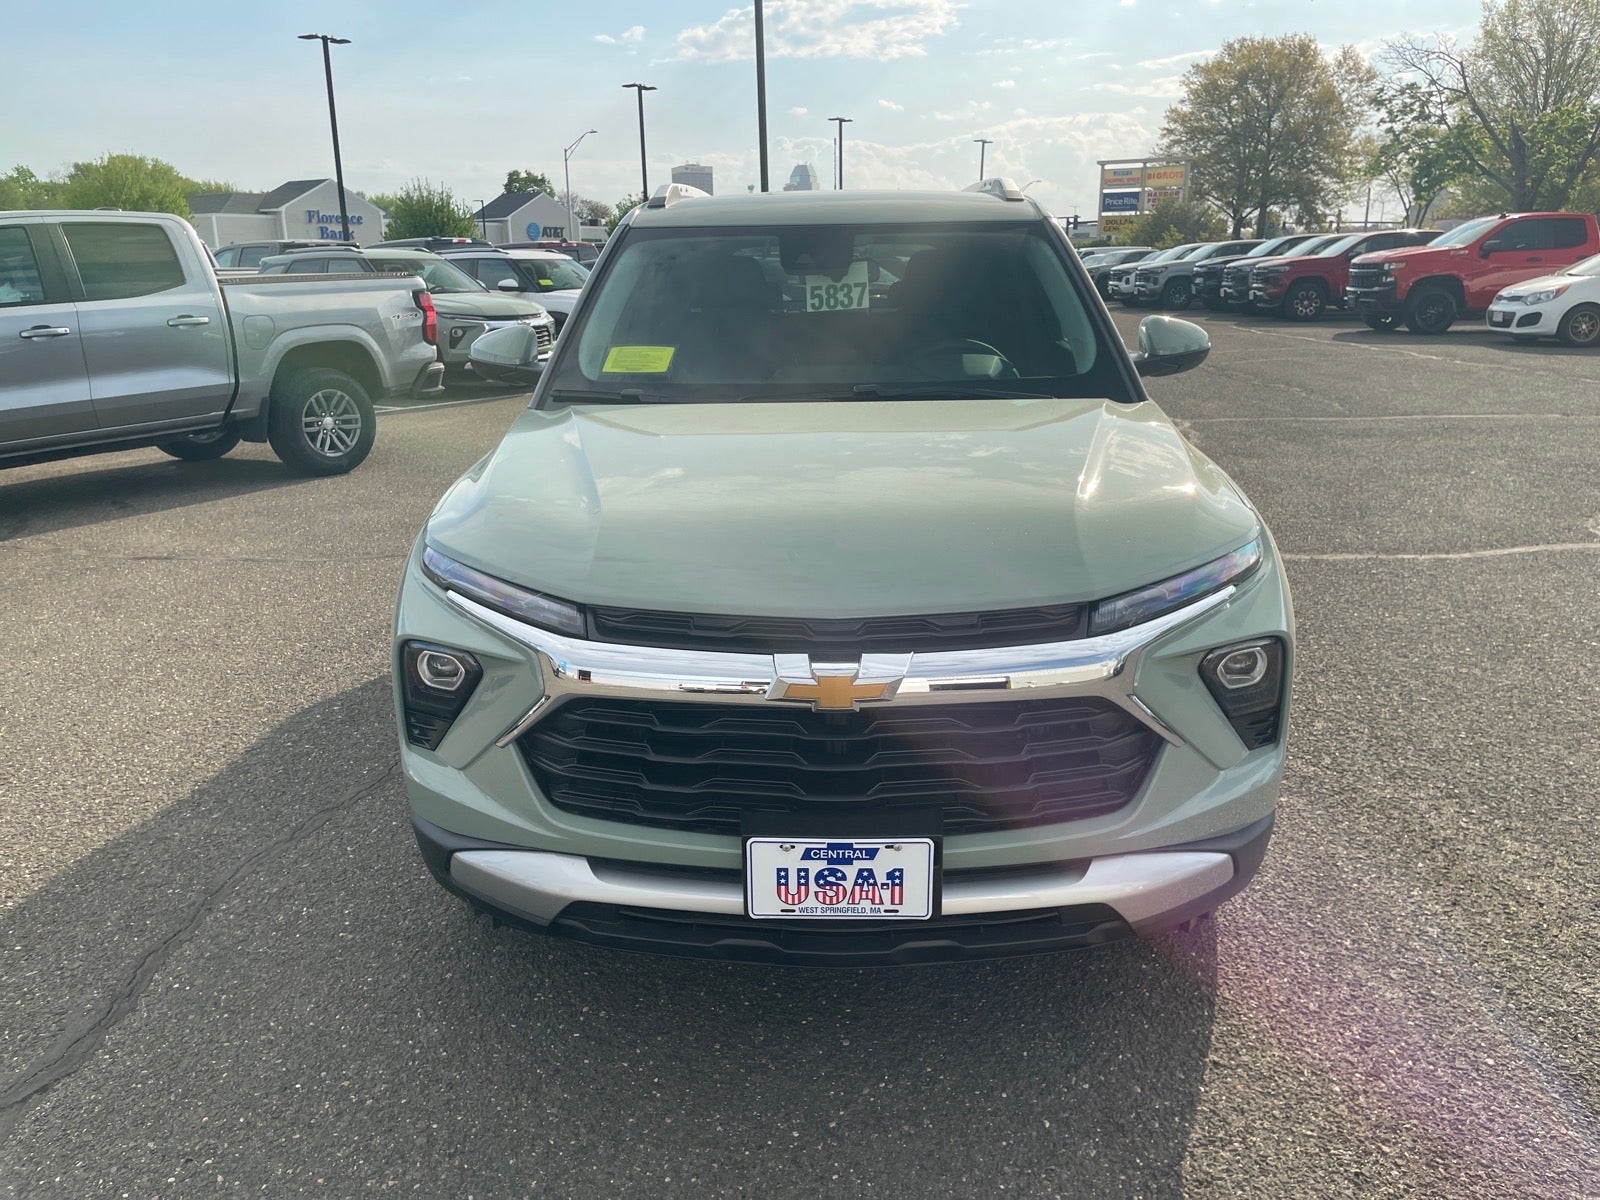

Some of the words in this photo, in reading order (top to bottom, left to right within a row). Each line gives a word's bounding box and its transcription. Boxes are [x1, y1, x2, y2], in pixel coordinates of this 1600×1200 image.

[1105, 198, 1123, 206] Price
[541, 226, 565, 238] AT&T
[809, 282, 867, 311] 5837
[810, 849, 870, 859] CENTRAL
[776, 867, 904, 906] USA-1
[798, 906, 819, 914] WEST
[820, 906, 868, 914] SPRINGFIELD,
[869, 906, 882, 914] MA
